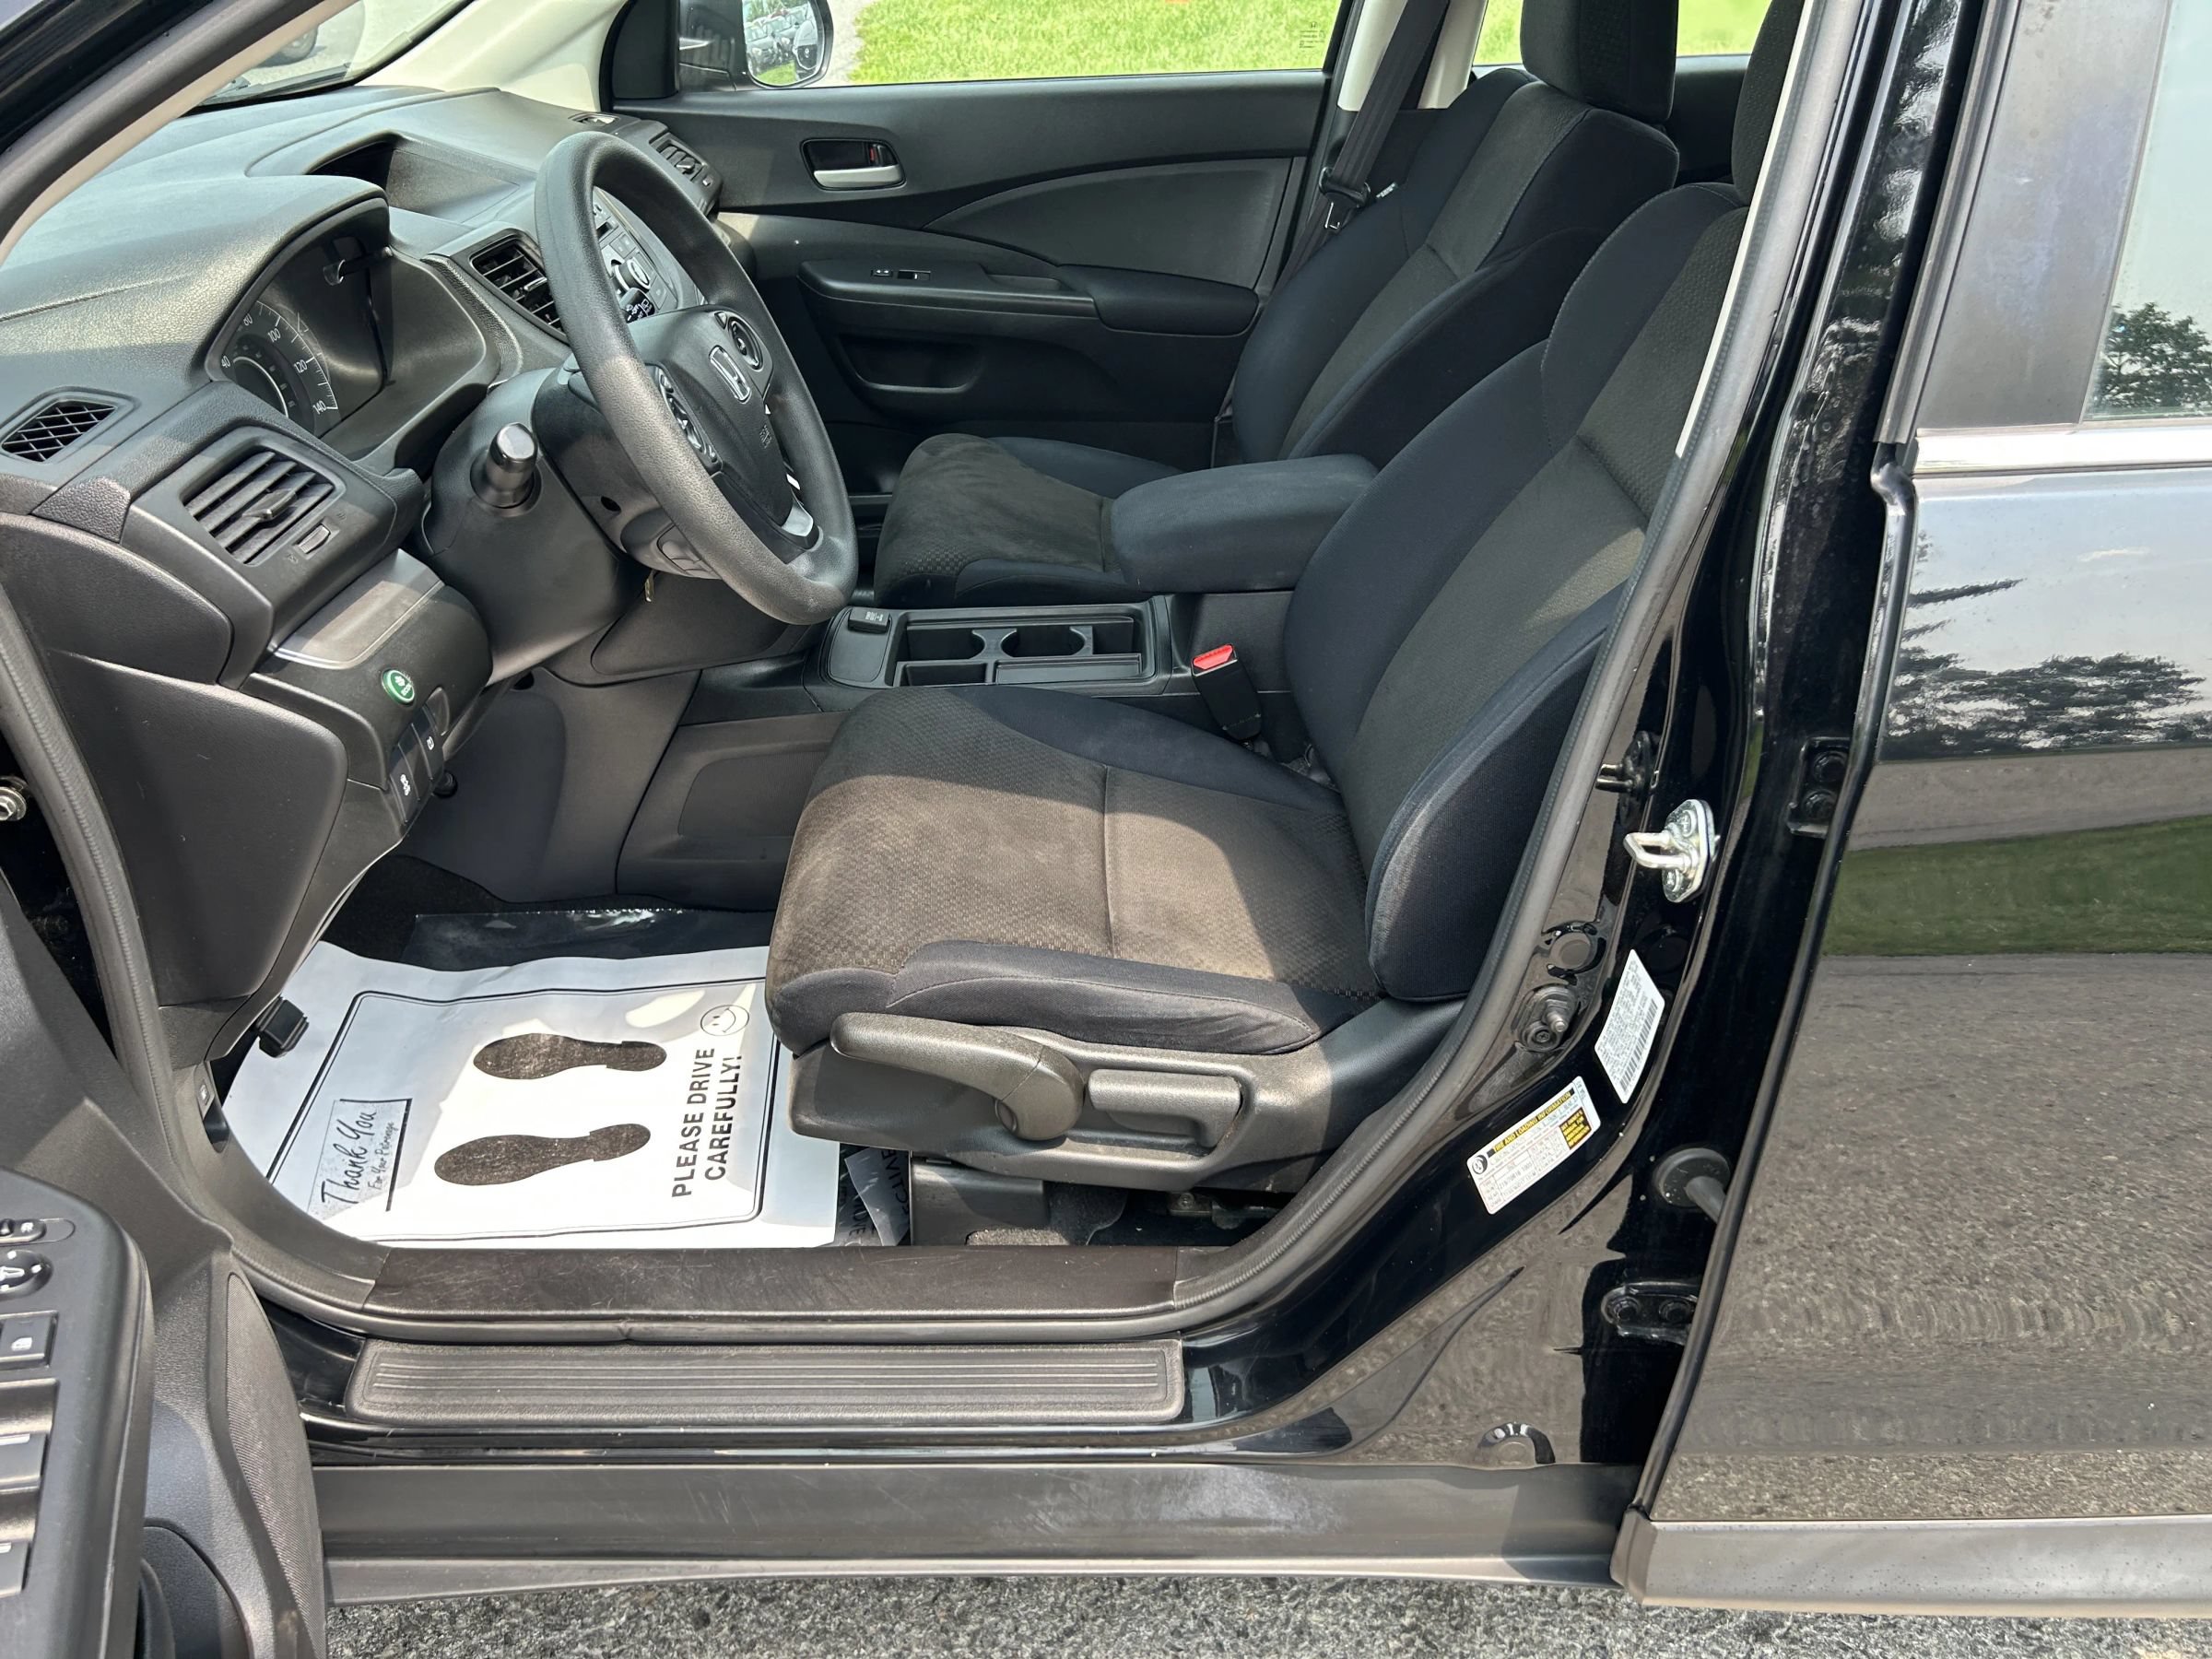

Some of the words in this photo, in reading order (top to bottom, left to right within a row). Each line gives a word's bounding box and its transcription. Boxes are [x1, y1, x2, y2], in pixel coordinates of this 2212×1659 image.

[267, 328, 281, 343] 100
[221, 355, 231, 369] 40
[294, 359, 308, 373] 120
[312, 400, 327, 415] 140
[687, 1048, 715, 1105] DRIVE
[336, 1112, 377, 1140] You
[704, 1055, 742, 1181] CAREFULLY!
[1504, 1132, 1515, 1146] AND
[1515, 1116, 1537, 1137] LOADING
[1537, 1091, 1571, 1121] INFORMATION
[321, 1143, 369, 1204] Thank
[671, 1112, 704, 1197] PLEASE
